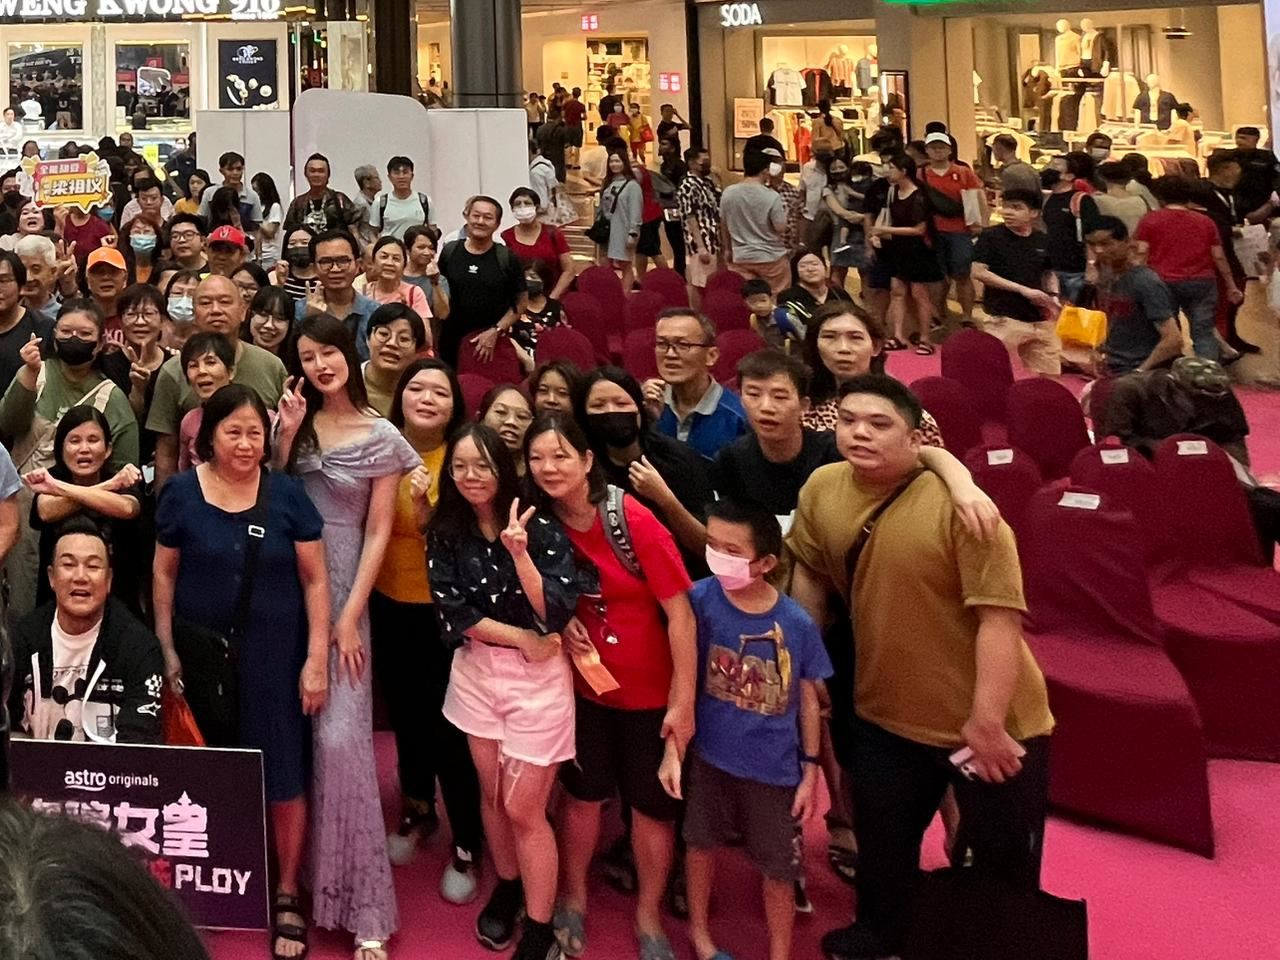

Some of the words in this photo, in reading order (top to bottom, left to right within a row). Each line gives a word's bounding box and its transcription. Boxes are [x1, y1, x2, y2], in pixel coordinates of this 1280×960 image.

[720, 3, 763, 27] SODA
[64, 769, 106, 788] astro
[108, 773, 159, 788] originals
[175, 864, 251, 895] PLOY
